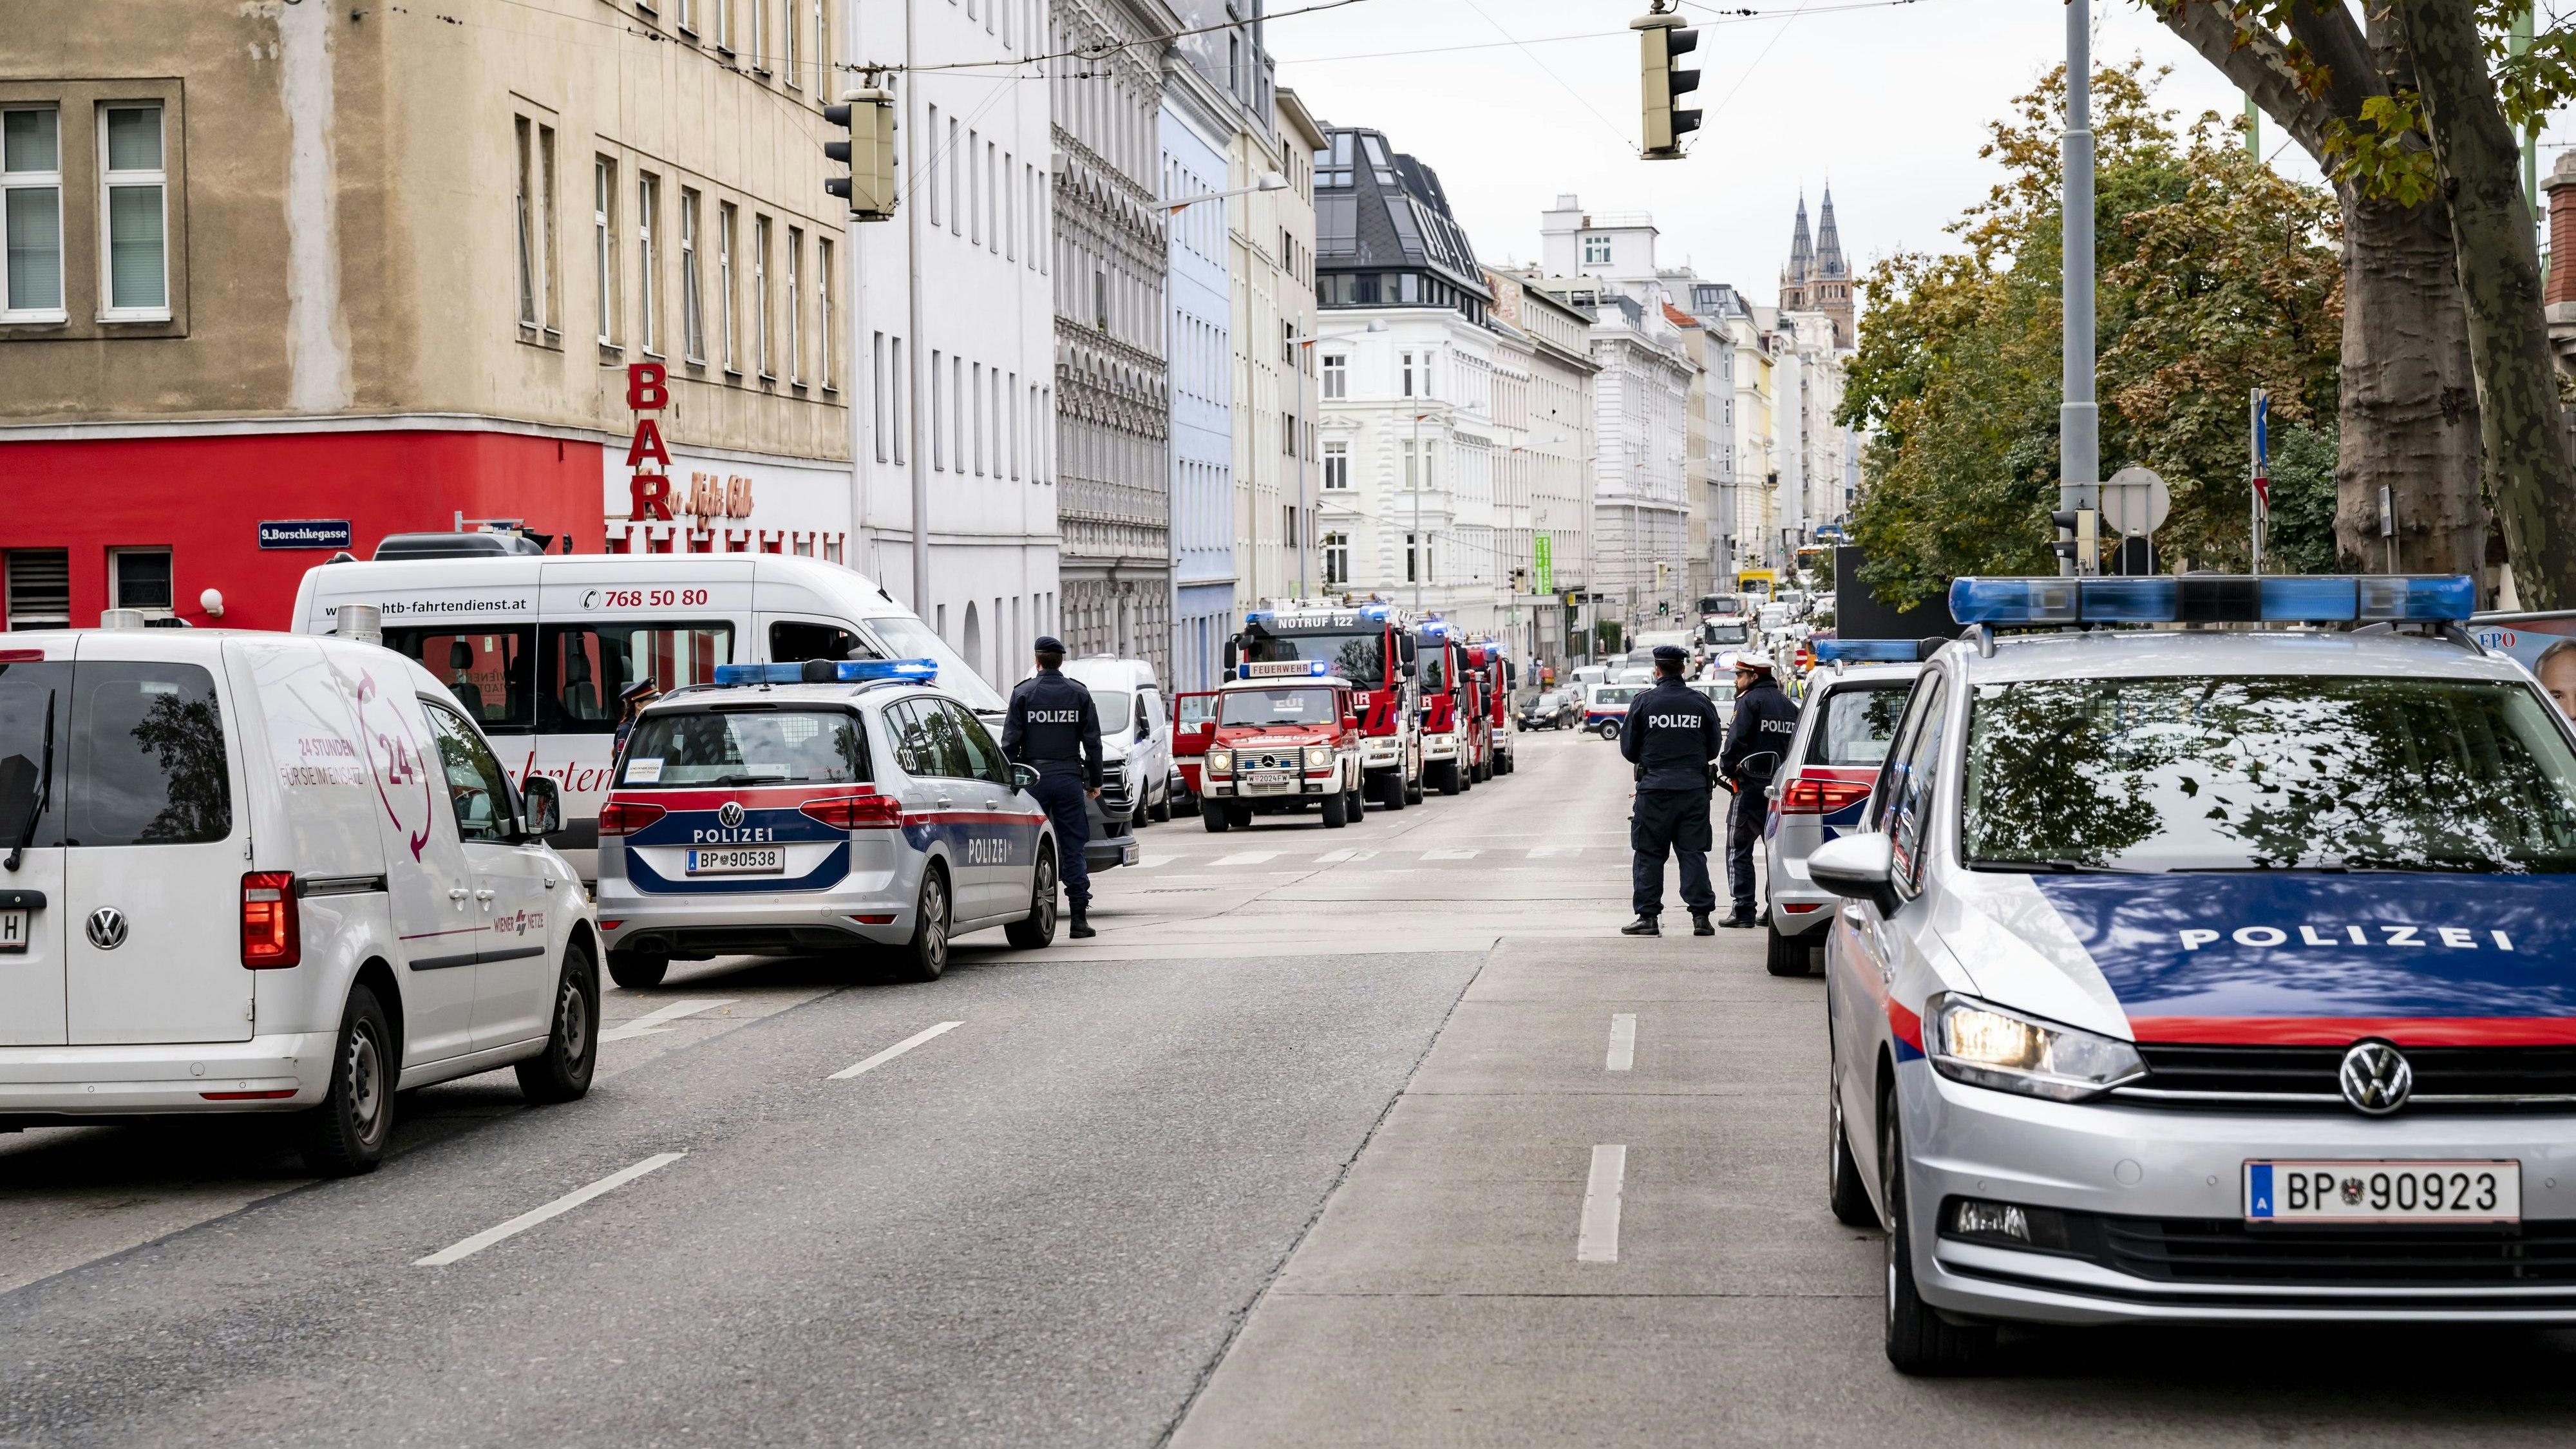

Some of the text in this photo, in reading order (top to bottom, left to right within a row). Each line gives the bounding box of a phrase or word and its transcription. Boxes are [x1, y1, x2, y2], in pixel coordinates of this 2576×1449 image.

[626, 364, 674, 521] BAR
[605, 589, 708, 607] 768 50 80
[1278, 616, 1354, 629] NOTRUF 122
[1253, 664, 1308, 674] FEUERWEHR
[1027, 710, 1079, 723] POLIZEI
[1649, 714, 1701, 728] POLIZEI
[299, 738, 355, 757] 24 STUNDEN
[379, 733, 414, 784] 24
[280, 763, 363, 786] FÜR SIE IM EINSATZ
[694, 828, 773, 843] POLIZEI
[701, 853, 719, 867] BP
[730, 851, 775, 867] 90538
[969, 838, 1007, 864] POLIZEI
[494, 913, 544, 933] WIENER NETZE
[2179, 926, 2514, 951] POLIZEI
[2287, 1172, 2335, 1210] BP
[2370, 1172, 2497, 1211] 90923
